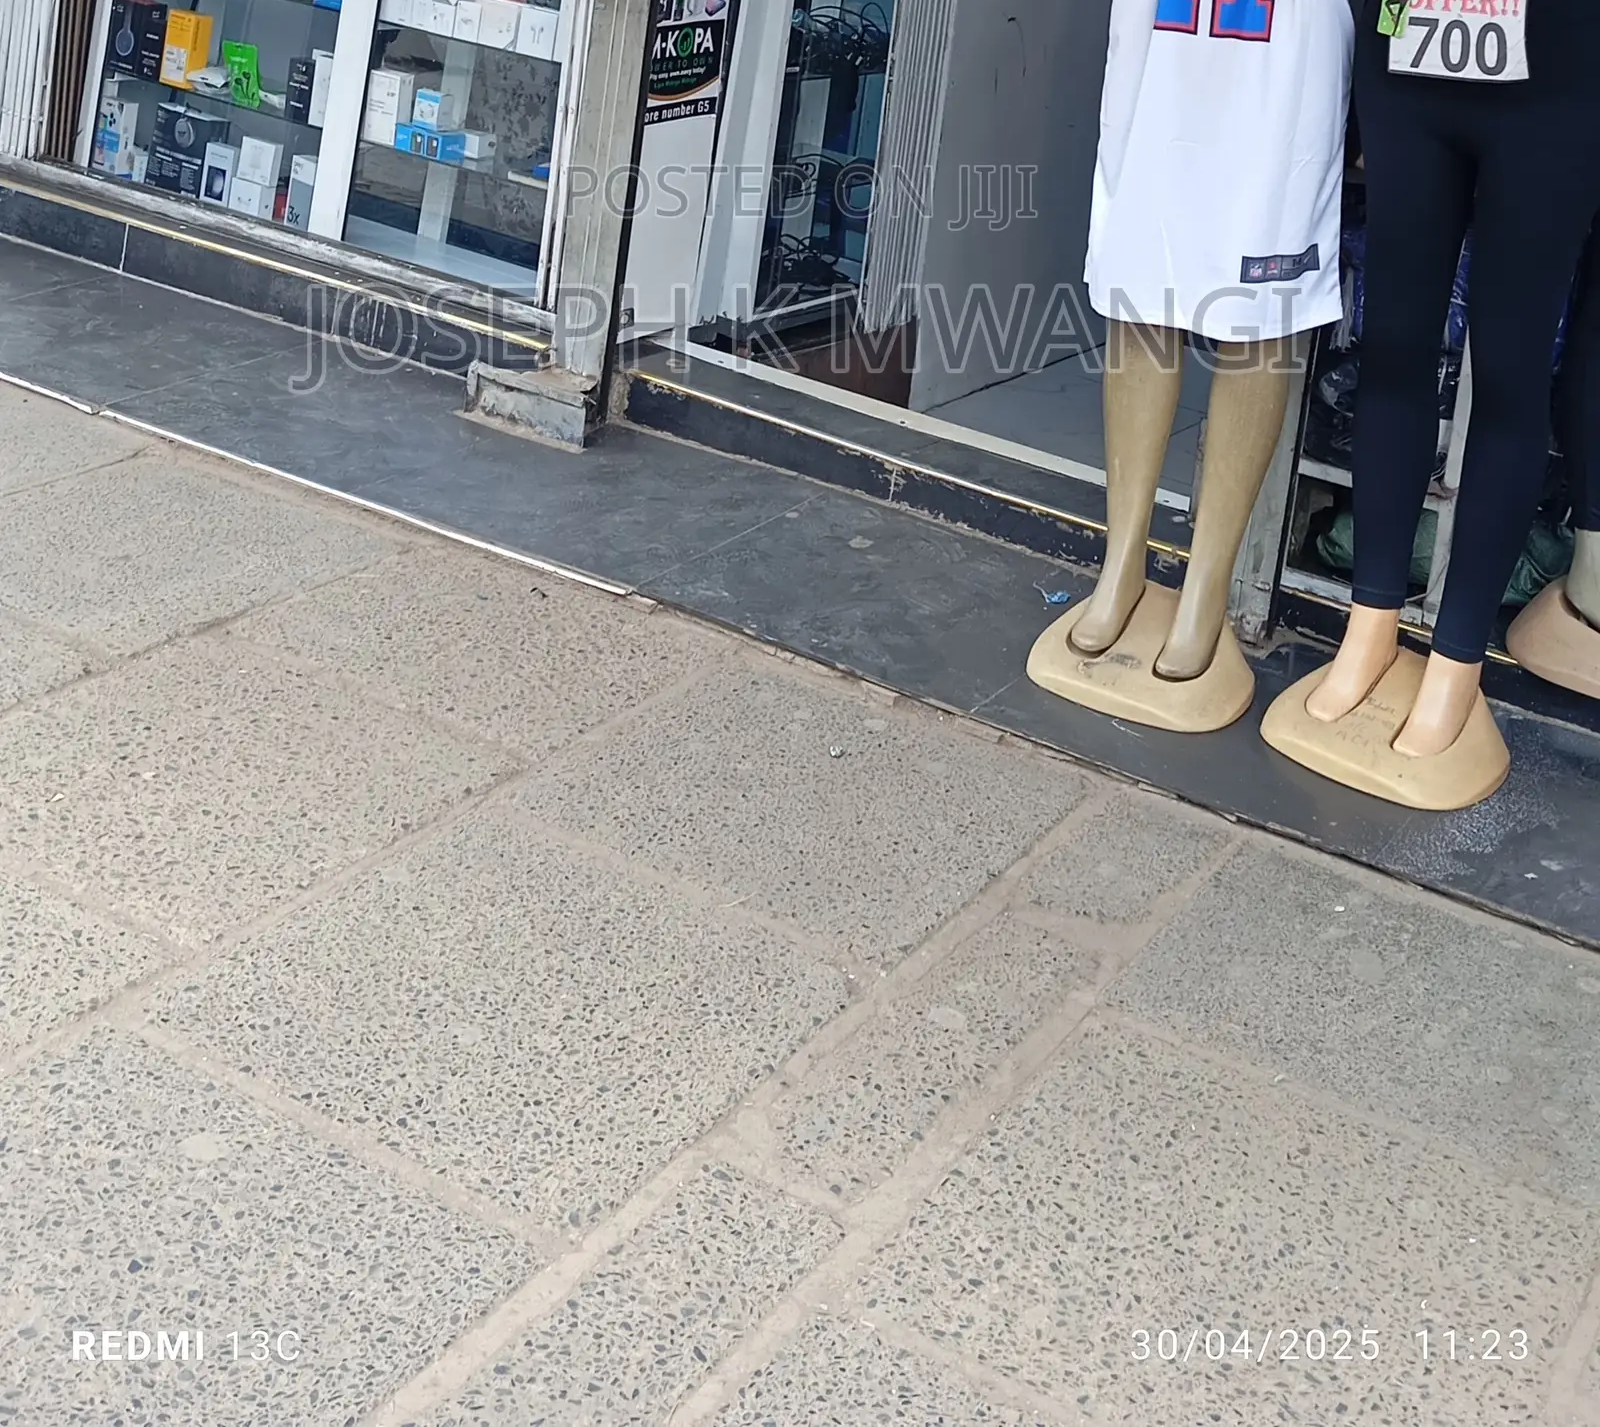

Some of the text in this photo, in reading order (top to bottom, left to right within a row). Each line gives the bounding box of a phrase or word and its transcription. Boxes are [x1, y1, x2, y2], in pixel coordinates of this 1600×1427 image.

[1408, 16, 1508, 76] 700
[661, 103, 695, 119] number
[697, 100, 710, 113] G5
